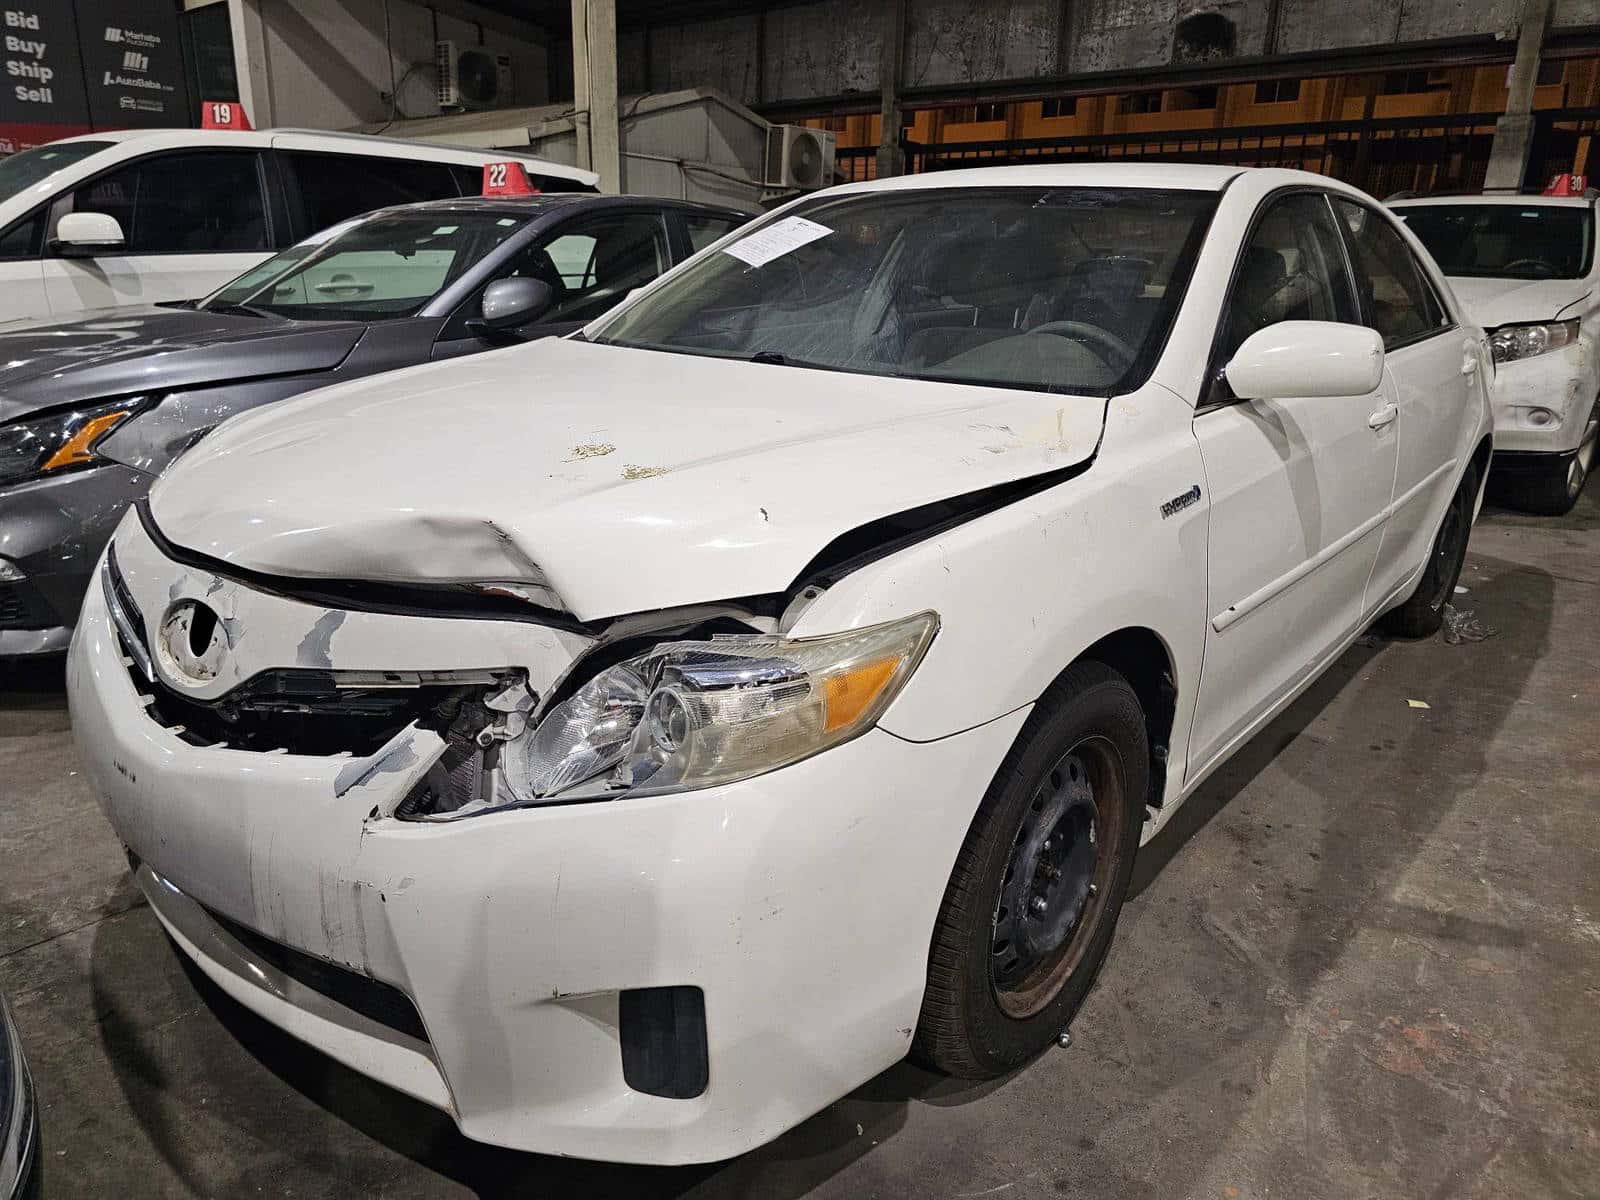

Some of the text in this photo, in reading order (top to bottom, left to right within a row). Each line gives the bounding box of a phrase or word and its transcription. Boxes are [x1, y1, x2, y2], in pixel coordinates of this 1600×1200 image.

[5, 11, 40, 30] Bid
[5, 36, 46, 59] Buy
[6, 61, 54, 84] Ship
[15, 86, 53, 103] Sell
[213, 103, 230, 124] 19
[490, 163, 506, 187] 22
[1570, 175, 1582, 191] 30
